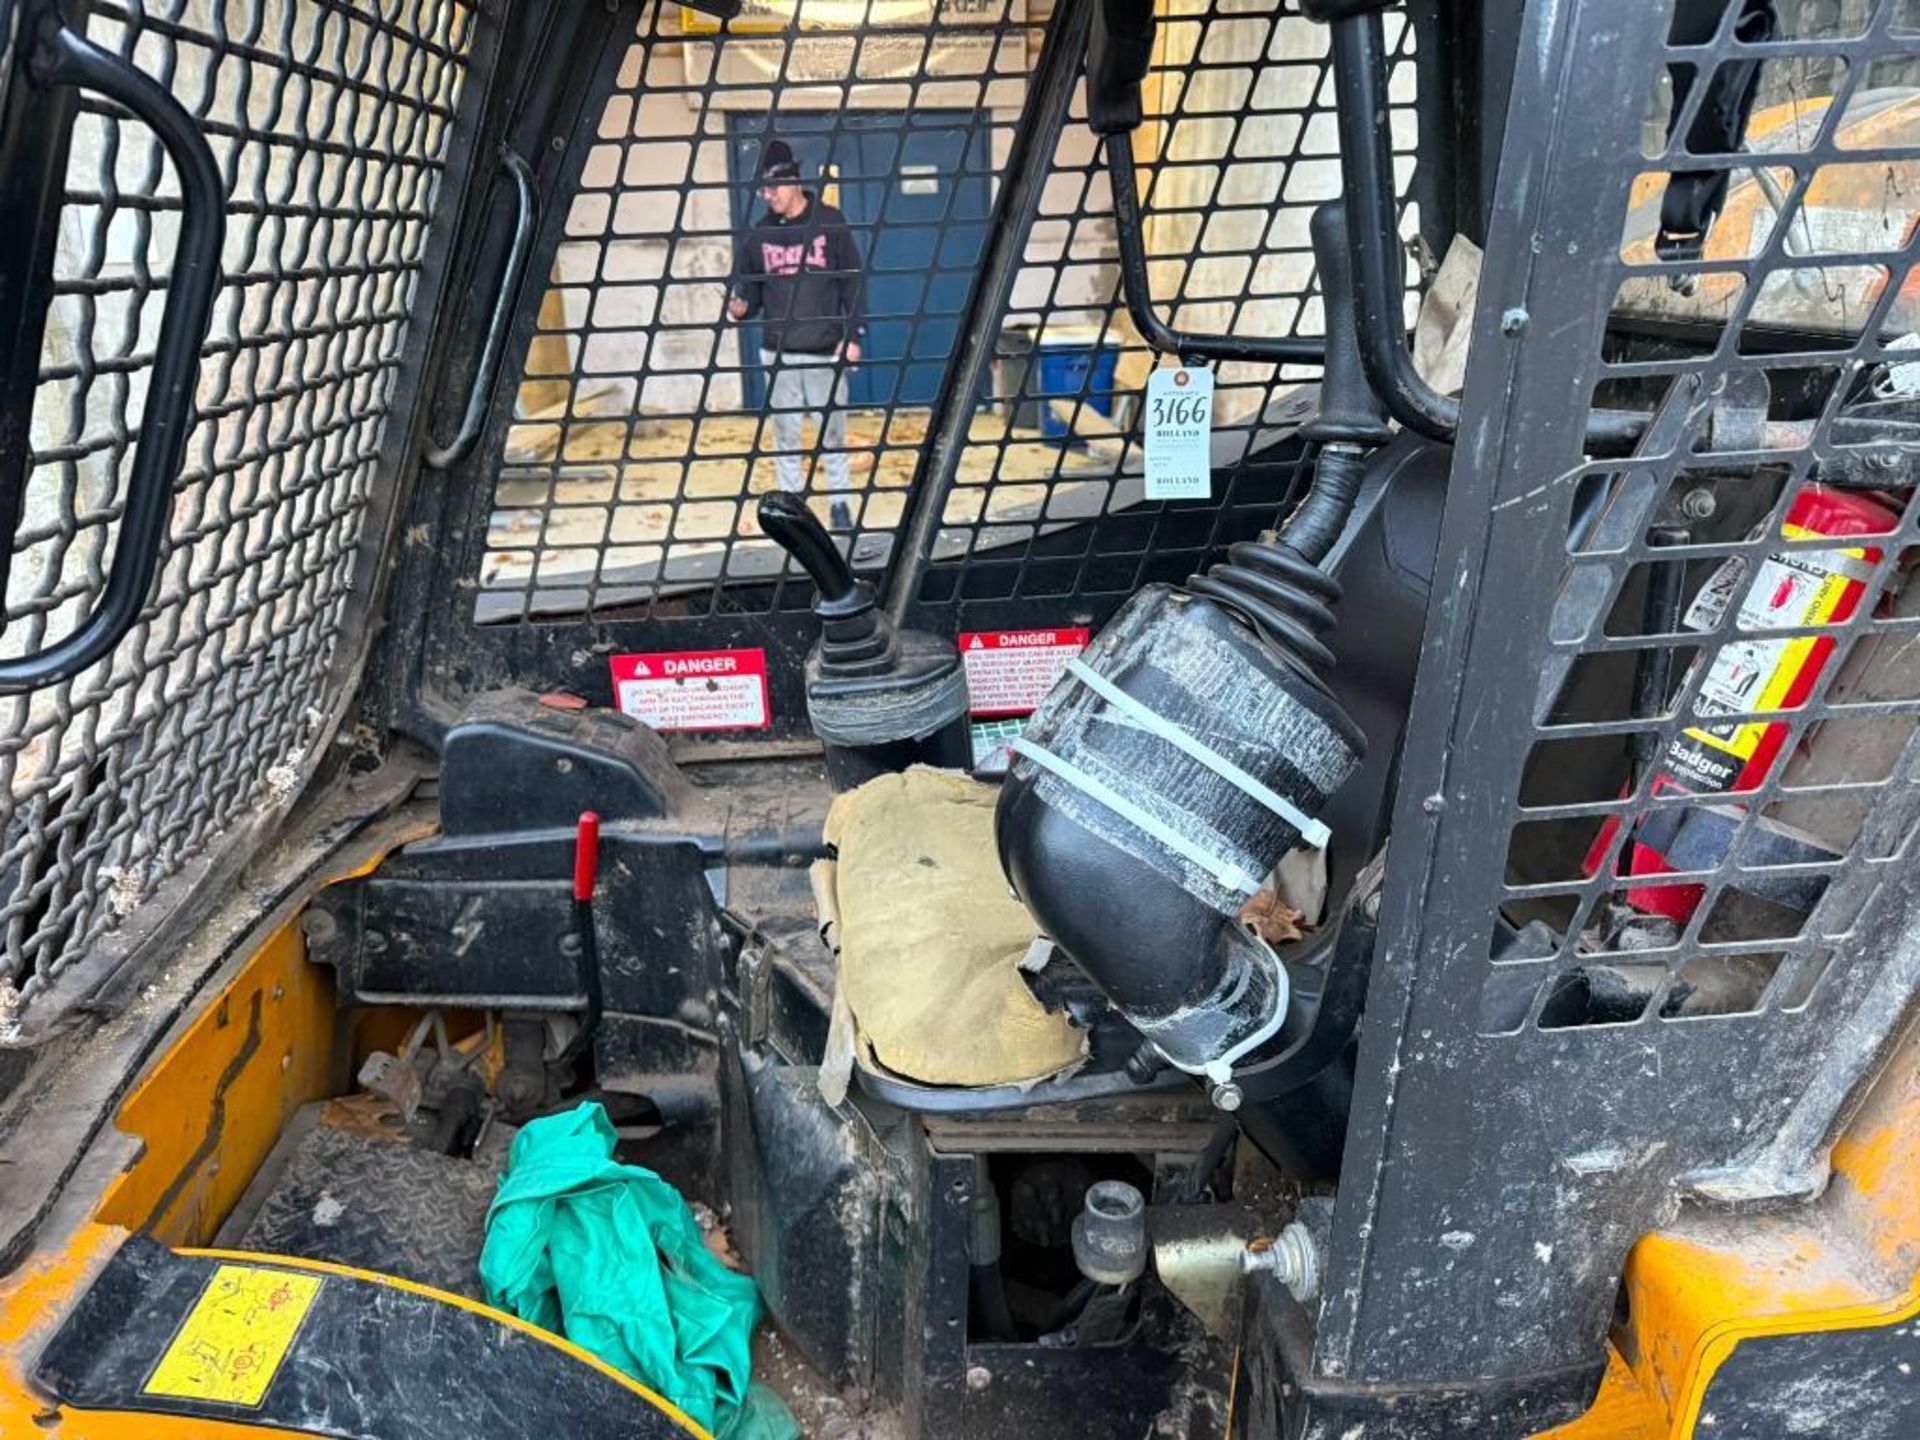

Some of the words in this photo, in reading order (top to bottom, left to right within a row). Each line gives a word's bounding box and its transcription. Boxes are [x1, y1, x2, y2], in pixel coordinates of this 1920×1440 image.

[762, 235, 826, 273] TEMLE
[1153, 396, 1207, 427] 3166
[1000, 632, 1056, 647] DANGER
[664, 658, 737, 675] DANGER
